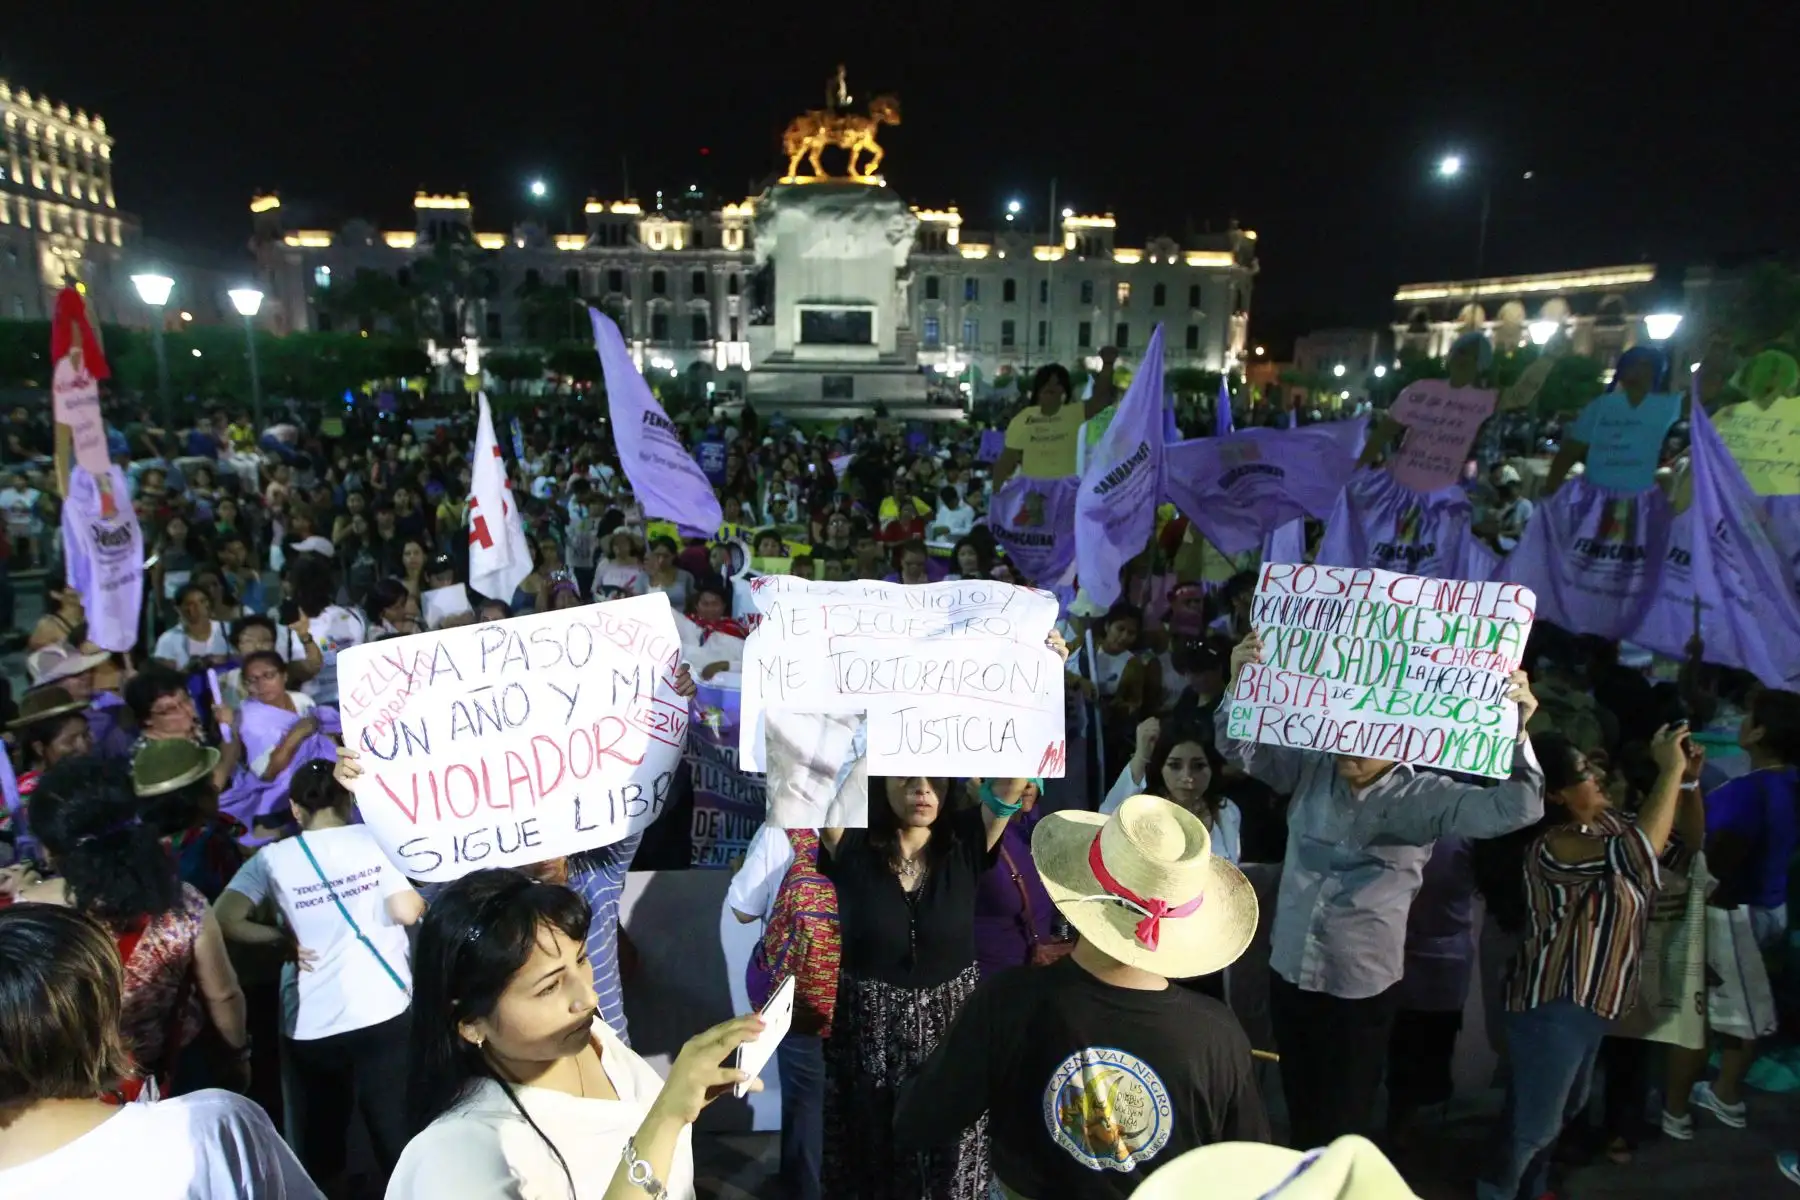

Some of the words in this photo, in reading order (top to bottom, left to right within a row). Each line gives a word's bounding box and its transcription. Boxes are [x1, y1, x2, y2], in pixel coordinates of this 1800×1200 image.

[753, 600, 808, 641] ME
[829, 604, 1010, 637] SECUESTRO
[998, 588, 1017, 614] Y
[1251, 595, 1355, 634] DENUNCIADA
[1352, 600, 1520, 658] PROCESADA
[475, 622, 593, 674] PASO
[1407, 665, 1426, 679] LA
[1410, 646, 1432, 657] DE
[758, 656, 808, 700] ME
[1236, 664, 1328, 707] BASTA
[1331, 686, 1354, 700] DE
[1350, 686, 1506, 726] ABUSOS
[362, 717, 430, 761] UN
[451, 682, 530, 740] AÑO
[547, 683, 580, 725] Y
[612, 664, 655, 706] MI
[881, 706, 1022, 756] JUSTICIA
[1229, 724, 1252, 738] EL
[1232, 707, 1253, 721] EN
[1256, 705, 1445, 764] RESIDENTADO
[375, 716, 646, 824] VIOLADOR
[397, 817, 542, 873] SIGUE
[1050, 1050, 1129, 1093] CARNAVAL
[1132, 1062, 1170, 1117] NEGRO
